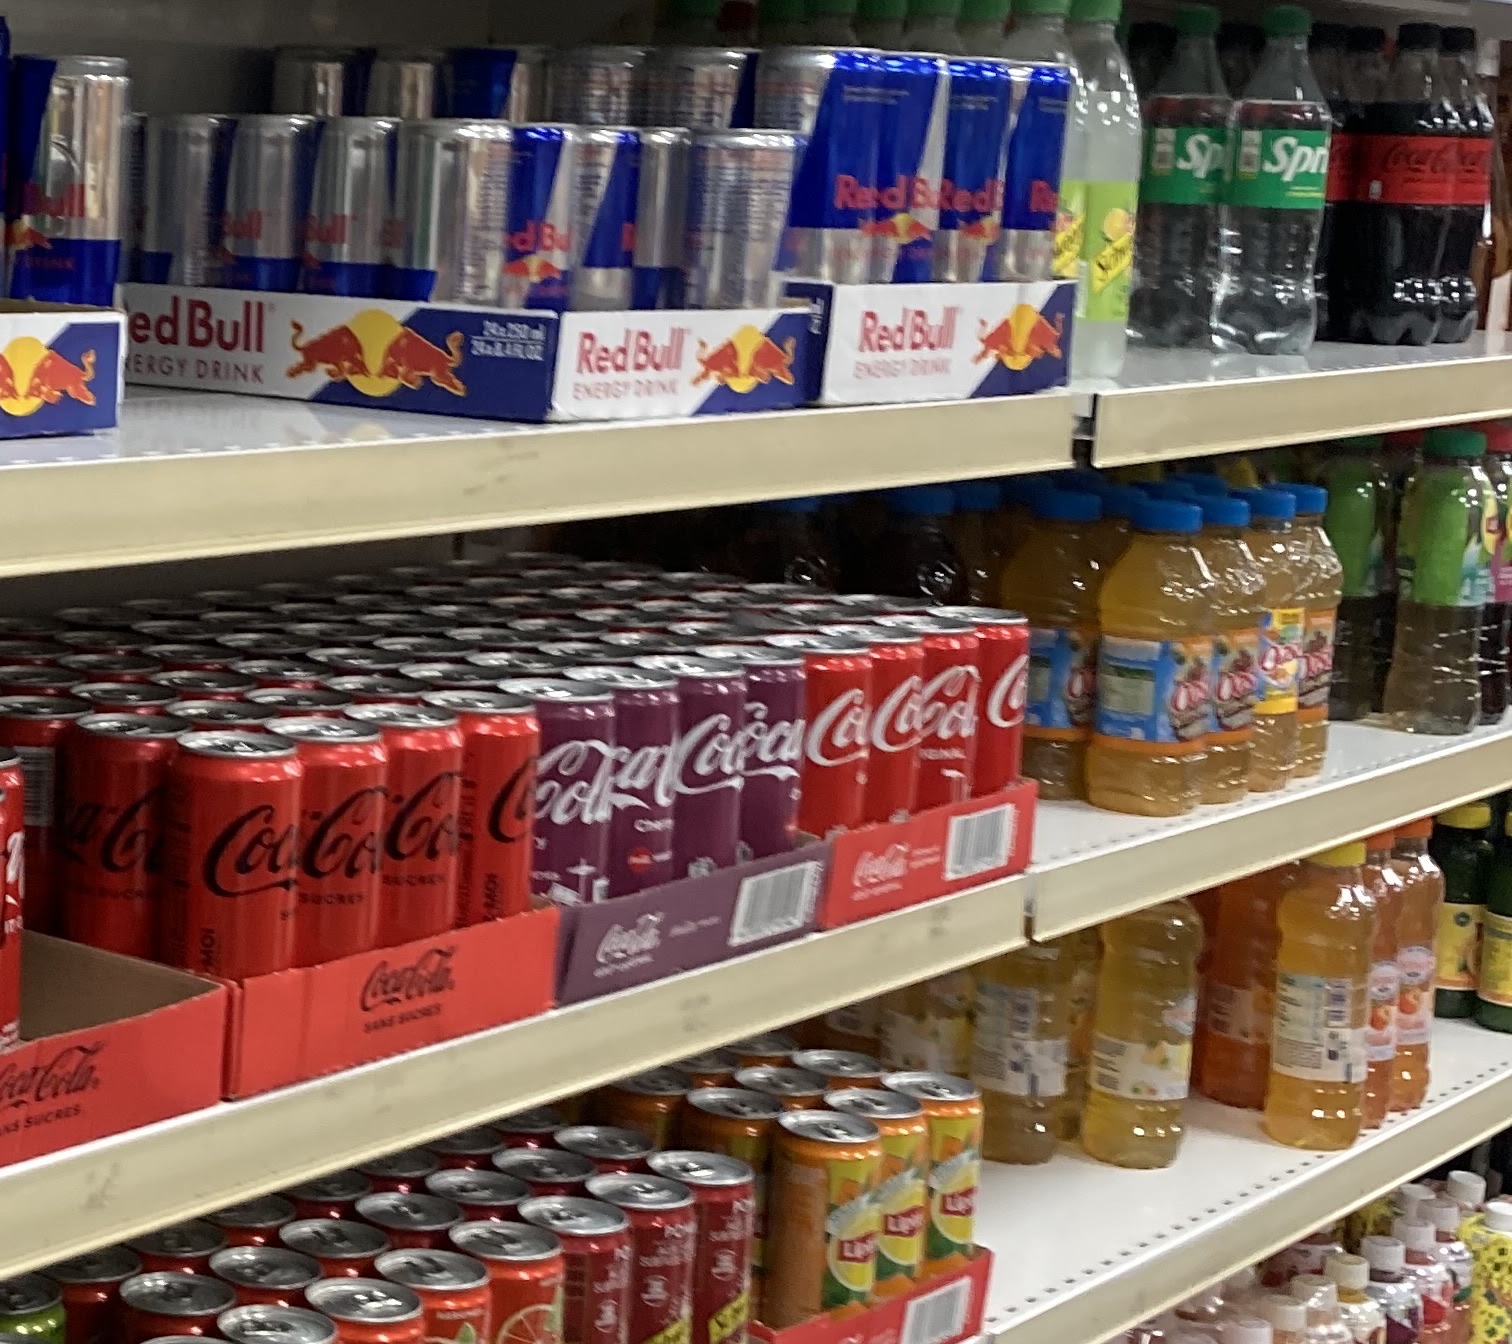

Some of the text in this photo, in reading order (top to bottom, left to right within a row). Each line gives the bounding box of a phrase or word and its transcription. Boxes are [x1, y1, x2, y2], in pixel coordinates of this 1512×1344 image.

[126, 294, 264, 353] ed Bull
[194, 358, 264, 385] DRINK
[576, 327, 628, 375] Red
[634, 326, 685, 372] Bull
